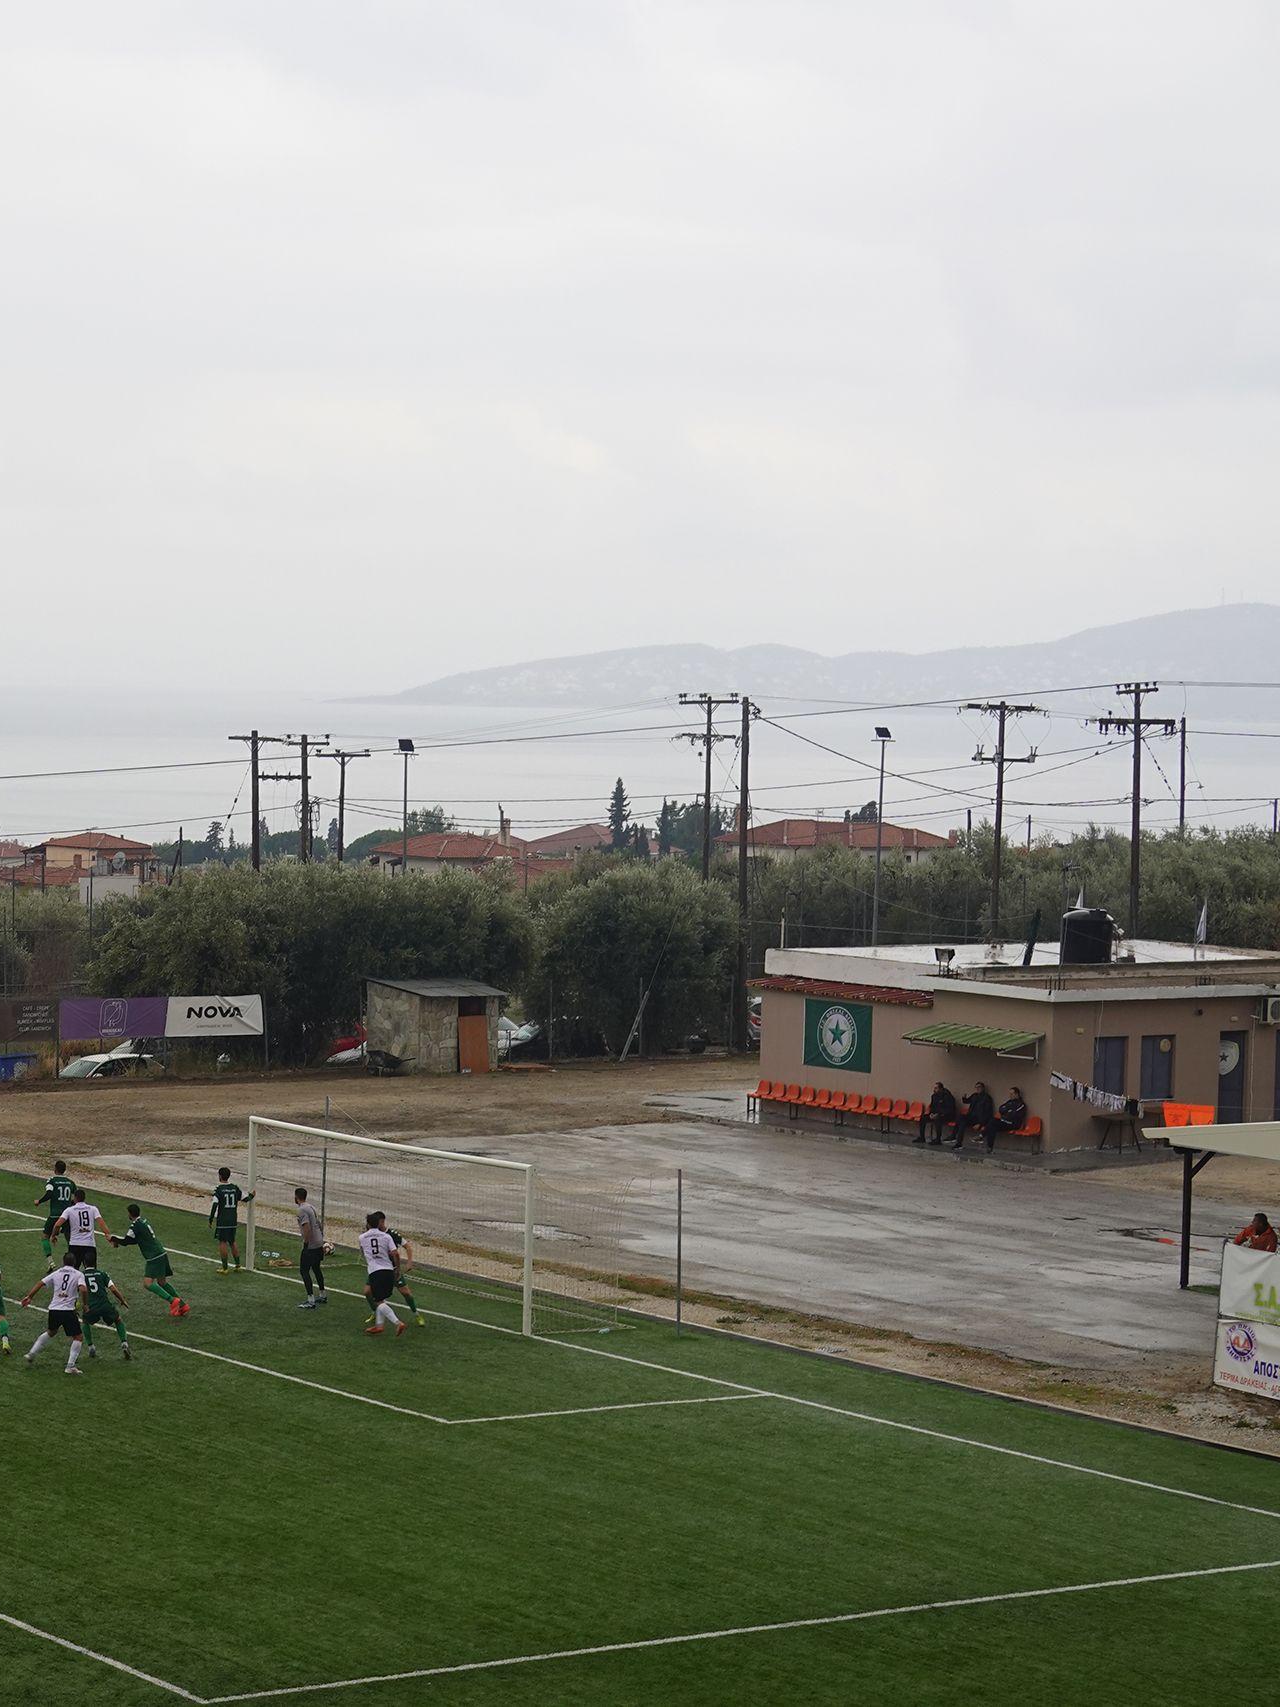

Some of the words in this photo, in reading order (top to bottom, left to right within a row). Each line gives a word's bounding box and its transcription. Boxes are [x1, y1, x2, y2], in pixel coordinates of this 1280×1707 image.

[186, 1006, 243, 1019] NOVA
[57, 1186, 71, 1201] 10
[224, 1194, 236, 1208] 11
[78, 1210, 90, 1227] 19
[370, 1238, 379, 1255] 9
[61, 1273, 70, 1291] 8
[88, 1276, 99, 1293] 5
[1253, 1360, 1280, 1379] ΑΠΟΣ
